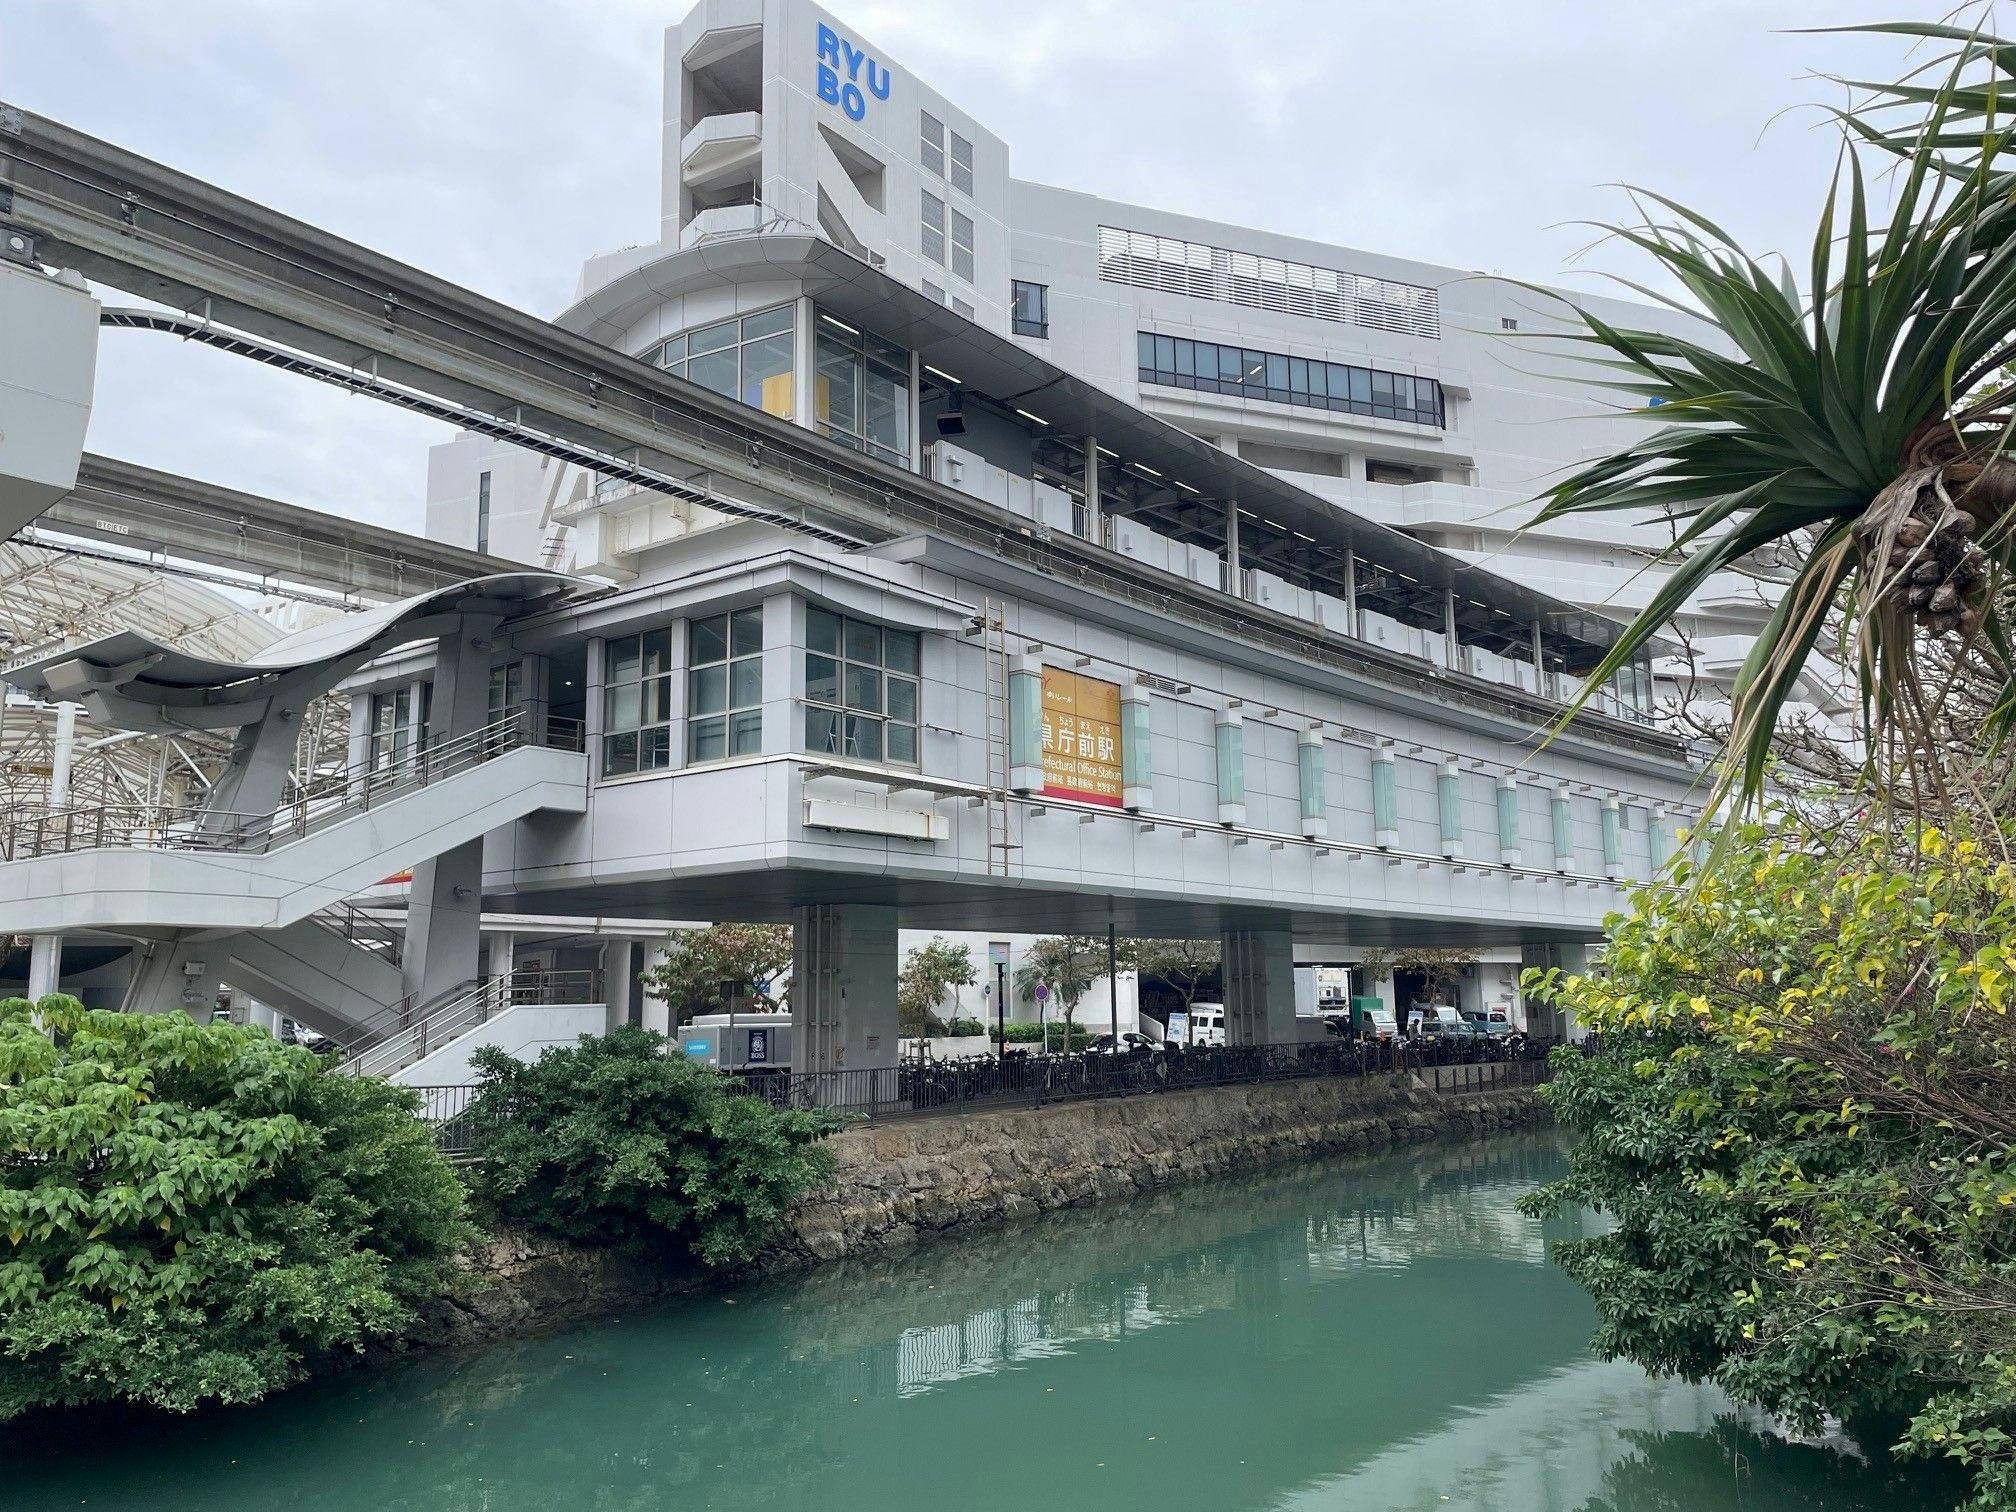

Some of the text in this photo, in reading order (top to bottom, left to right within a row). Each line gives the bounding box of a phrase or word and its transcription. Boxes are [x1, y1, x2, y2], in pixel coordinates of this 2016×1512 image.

[817, 20, 891, 101] RYU
[816, 61, 866, 122] BO
[1041, 723, 1115, 762] 県庁前駅
[1077, 762, 1097, 777] Office
[1098, 766, 1122, 781] Station
